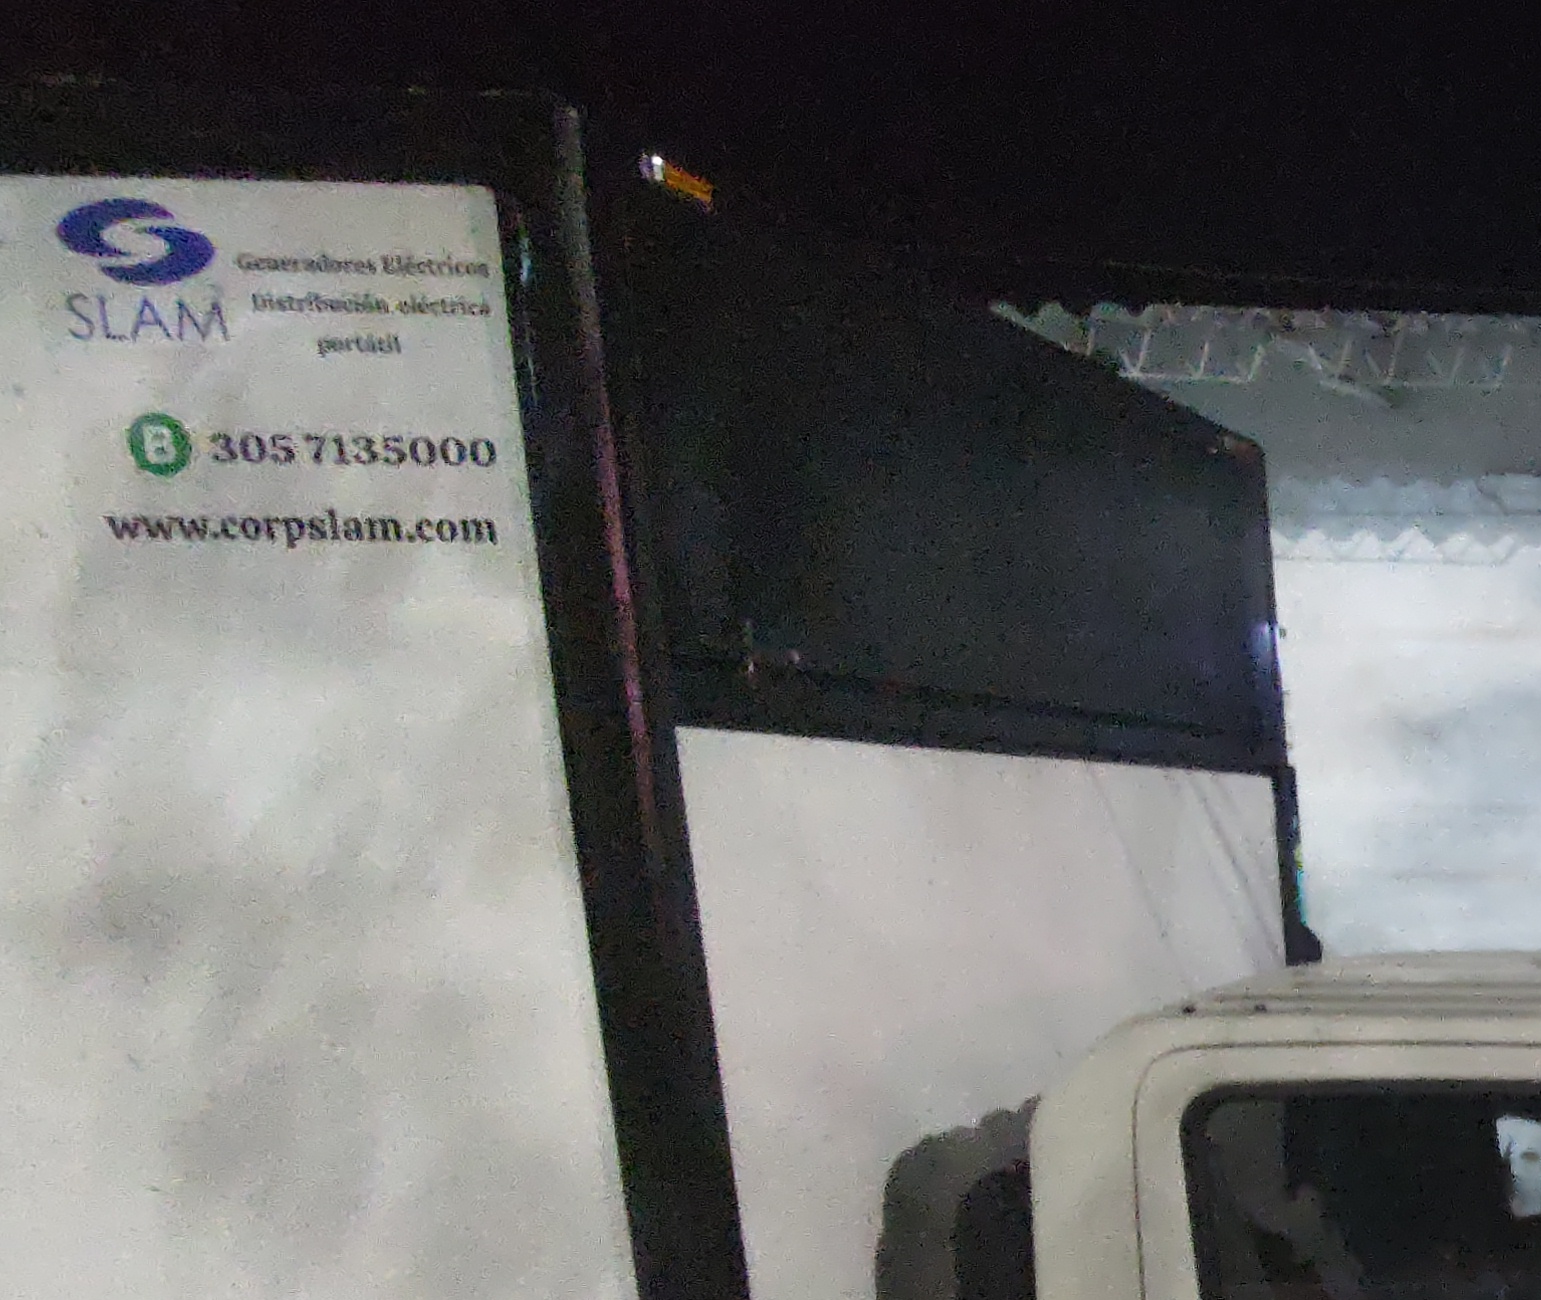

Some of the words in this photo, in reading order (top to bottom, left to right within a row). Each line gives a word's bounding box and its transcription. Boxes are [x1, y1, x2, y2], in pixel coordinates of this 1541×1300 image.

[237, 252, 375, 276] Generadores
[66, 291, 230, 343] SLAM
[210, 432, 296, 465] 305
[304, 433, 497, 468] 7135000
[104, 507, 499, 550] www.corpslam.com
